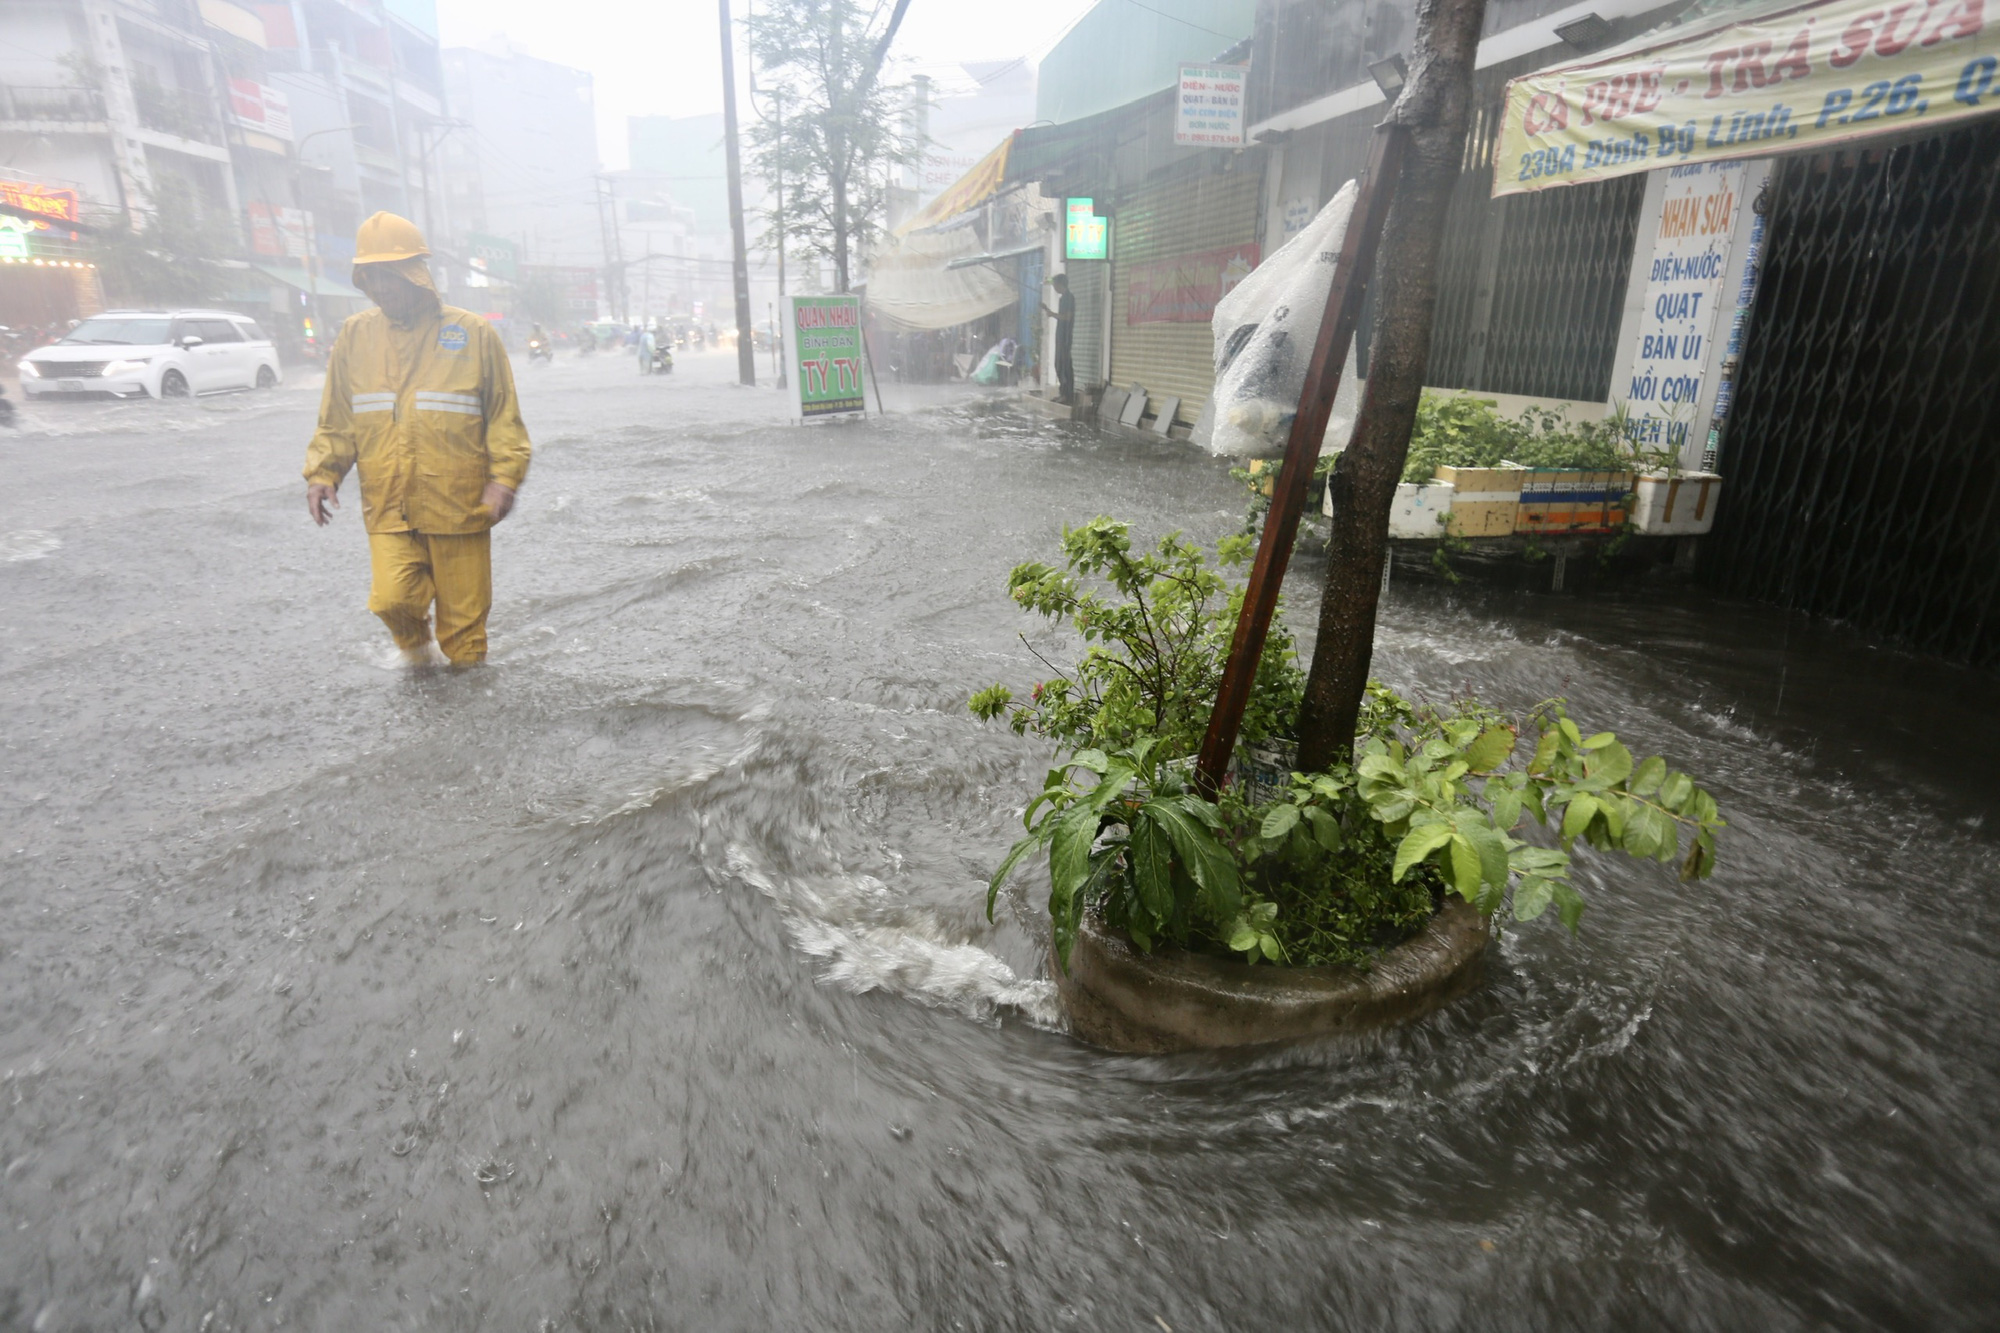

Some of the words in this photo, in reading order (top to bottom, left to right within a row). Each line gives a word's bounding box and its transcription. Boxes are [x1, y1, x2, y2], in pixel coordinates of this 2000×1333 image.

[1581, 58, 1667, 126] PHÊ
[1518, 144, 1576, 181] 230A
[1656, 120, 1697, 160] Bộ
[1815, 73, 1929, 129] P.26,
[1659, 186, 1702, 247] NHẬN
[1701, 177, 1733, 236] SỬA
[1650, 251, 1722, 286] ĐIỆN-NƯỚC
[797, 301, 827, 332] QUÁN
[829, 302, 858, 330] NHẬU
[1655, 292, 1703, 324] QUẠT
[804, 336, 829, 349] BÌNH
[832, 335, 853, 348] DÂN
[1641, 328, 1678, 360] BÀN
[1682, 325, 1702, 361] ỦI
[802, 352, 829, 394] TÝ
[834, 358, 861, 392] TY
[1628, 365, 1658, 401] NỒI
[1661, 374, 1699, 404] CƠM
